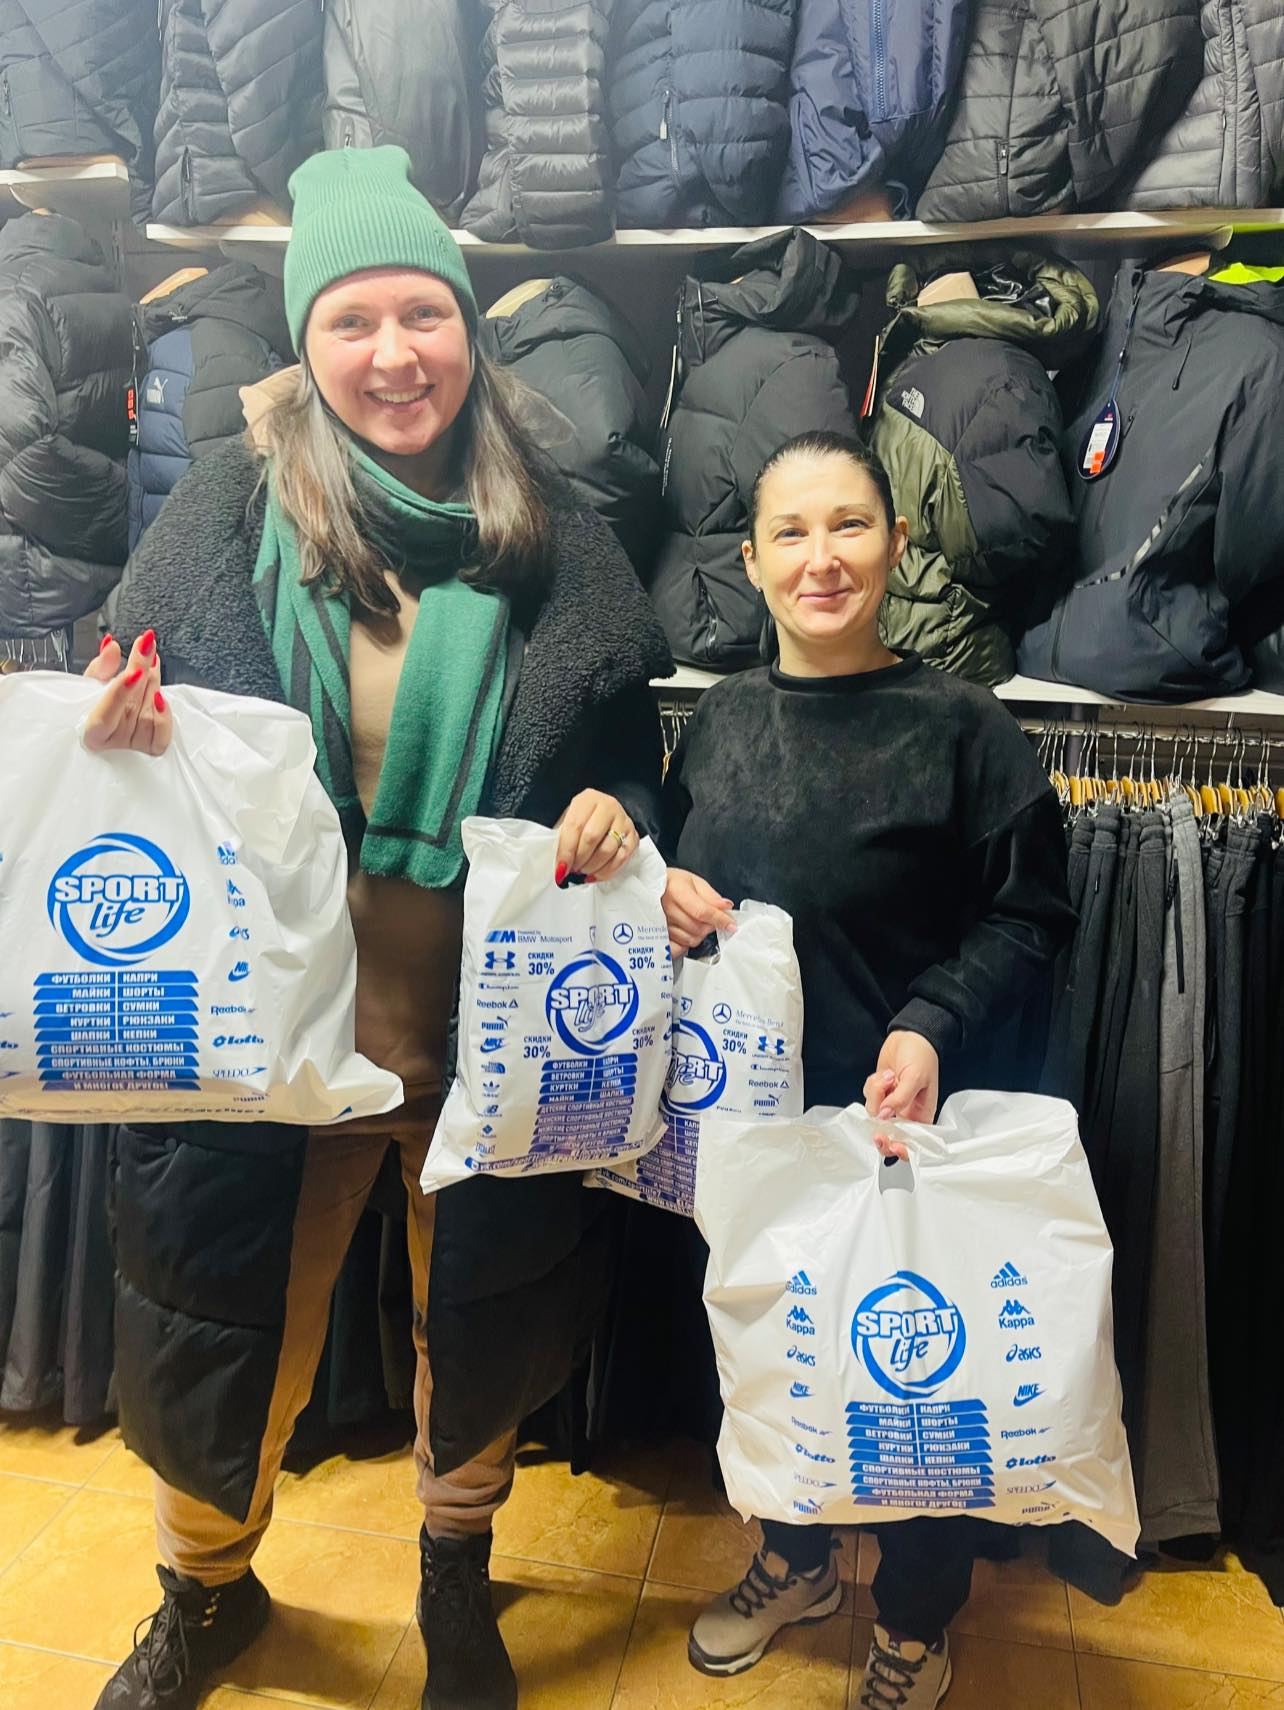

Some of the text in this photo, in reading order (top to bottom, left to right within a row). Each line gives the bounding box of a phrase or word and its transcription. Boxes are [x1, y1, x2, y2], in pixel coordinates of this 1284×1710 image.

[53, 874, 185, 904] SPORT
[89, 900, 146, 938] life
[528, 951, 555, 960] СКИДКИ
[628, 946, 654, 955] СКИДКИ
[528, 962, 555, 975] 30%
[629, 956, 655, 970] 30%
[51, 973, 111, 984] ФУТБОЛКИ
[122, 973, 158, 983] КАПРИ
[72, 986, 111, 998] МАЙКИ
[122, 987, 165, 997] ШОРТЫ
[550, 983, 634, 1010] SPORT
[55, 1002, 111, 1014] ВЕТРОВКИ
[122, 1001, 160, 1011] СУМКИ
[476, 999, 507, 1009] Reebok
[70, 1016, 111, 1027] КУРТКИ
[122, 1015, 175, 1025] РЮКЗАКИ
[70, 1030, 111, 1041] ШАПКИ
[122, 1029, 158, 1039] КЕПКИ
[632, 1025, 656, 1036] СКИДКИ
[722, 1028, 748, 1040] СКИДКИ
[227, 1034, 264, 1045] lotto
[523, 1035, 552, 1043] СКИДКИ
[632, 1034, 654, 1051] 30%
[50, 1042, 184, 1054] СПОРТИВНЫЕ КОСТЮМЫ
[523, 1045, 551, 1059] 30%
[722, 1038, 747, 1055] 30%
[51, 1057, 112, 1068] СПОРТИВНЫЕ
[152, 1056, 185, 1066] БРЮКИ
[552, 1061, 588, 1070] ФУТБОЛКИ
[62, 1070, 176, 1080] ФУТБОЛЬНАЯ ФОРМА
[551, 1071, 585, 1081] ВЕТРОВКИ
[549, 1083, 579, 1092] КУРТКИ
[748, 1079, 778, 1089] Reebok
[990, 1276, 1028, 1288] adidas
[786, 1317, 815, 1336] Kappa
[856, 1306, 957, 1339] SPORT
[998, 1316, 1035, 1330] Kappa
[890, 1337, 929, 1372] life
[793, 1381, 809, 1393] NIKE
[1017, 1383, 1040, 1397] NIKE
[859, 1404, 910, 1415] ФУТБОЛКИ
[920, 1404, 950, 1414] КАПРИ
[879, 1418, 911, 1428] МАЙКИ
[921, 1416, 958, 1426] ШОРТЫ
[865, 1429, 913, 1441] ВЕТРОВКИ
[922, 1430, 955, 1440] СУМКИ
[1001, 1428, 1037, 1440] Reebok
[878, 1442, 914, 1453] КУРТКИ
[923, 1441, 970, 1452] РЮКЗАКИ
[879, 1454, 914, 1465] ШАПКИ
[924, 1455, 955, 1465] КЕПКИ
[1019, 1454, 1057, 1467] lotto
[862, 1464, 980, 1476] СПОРТИВНЫЕ КОСТЮМЫ
[863, 1476, 917, 1487] СПОРТИВНЫЕ
[952, 1478, 982, 1487] БРЮКИ
[872, 1488, 974, 1497] ФУТБОЛЬНАЯ ФОРМА
